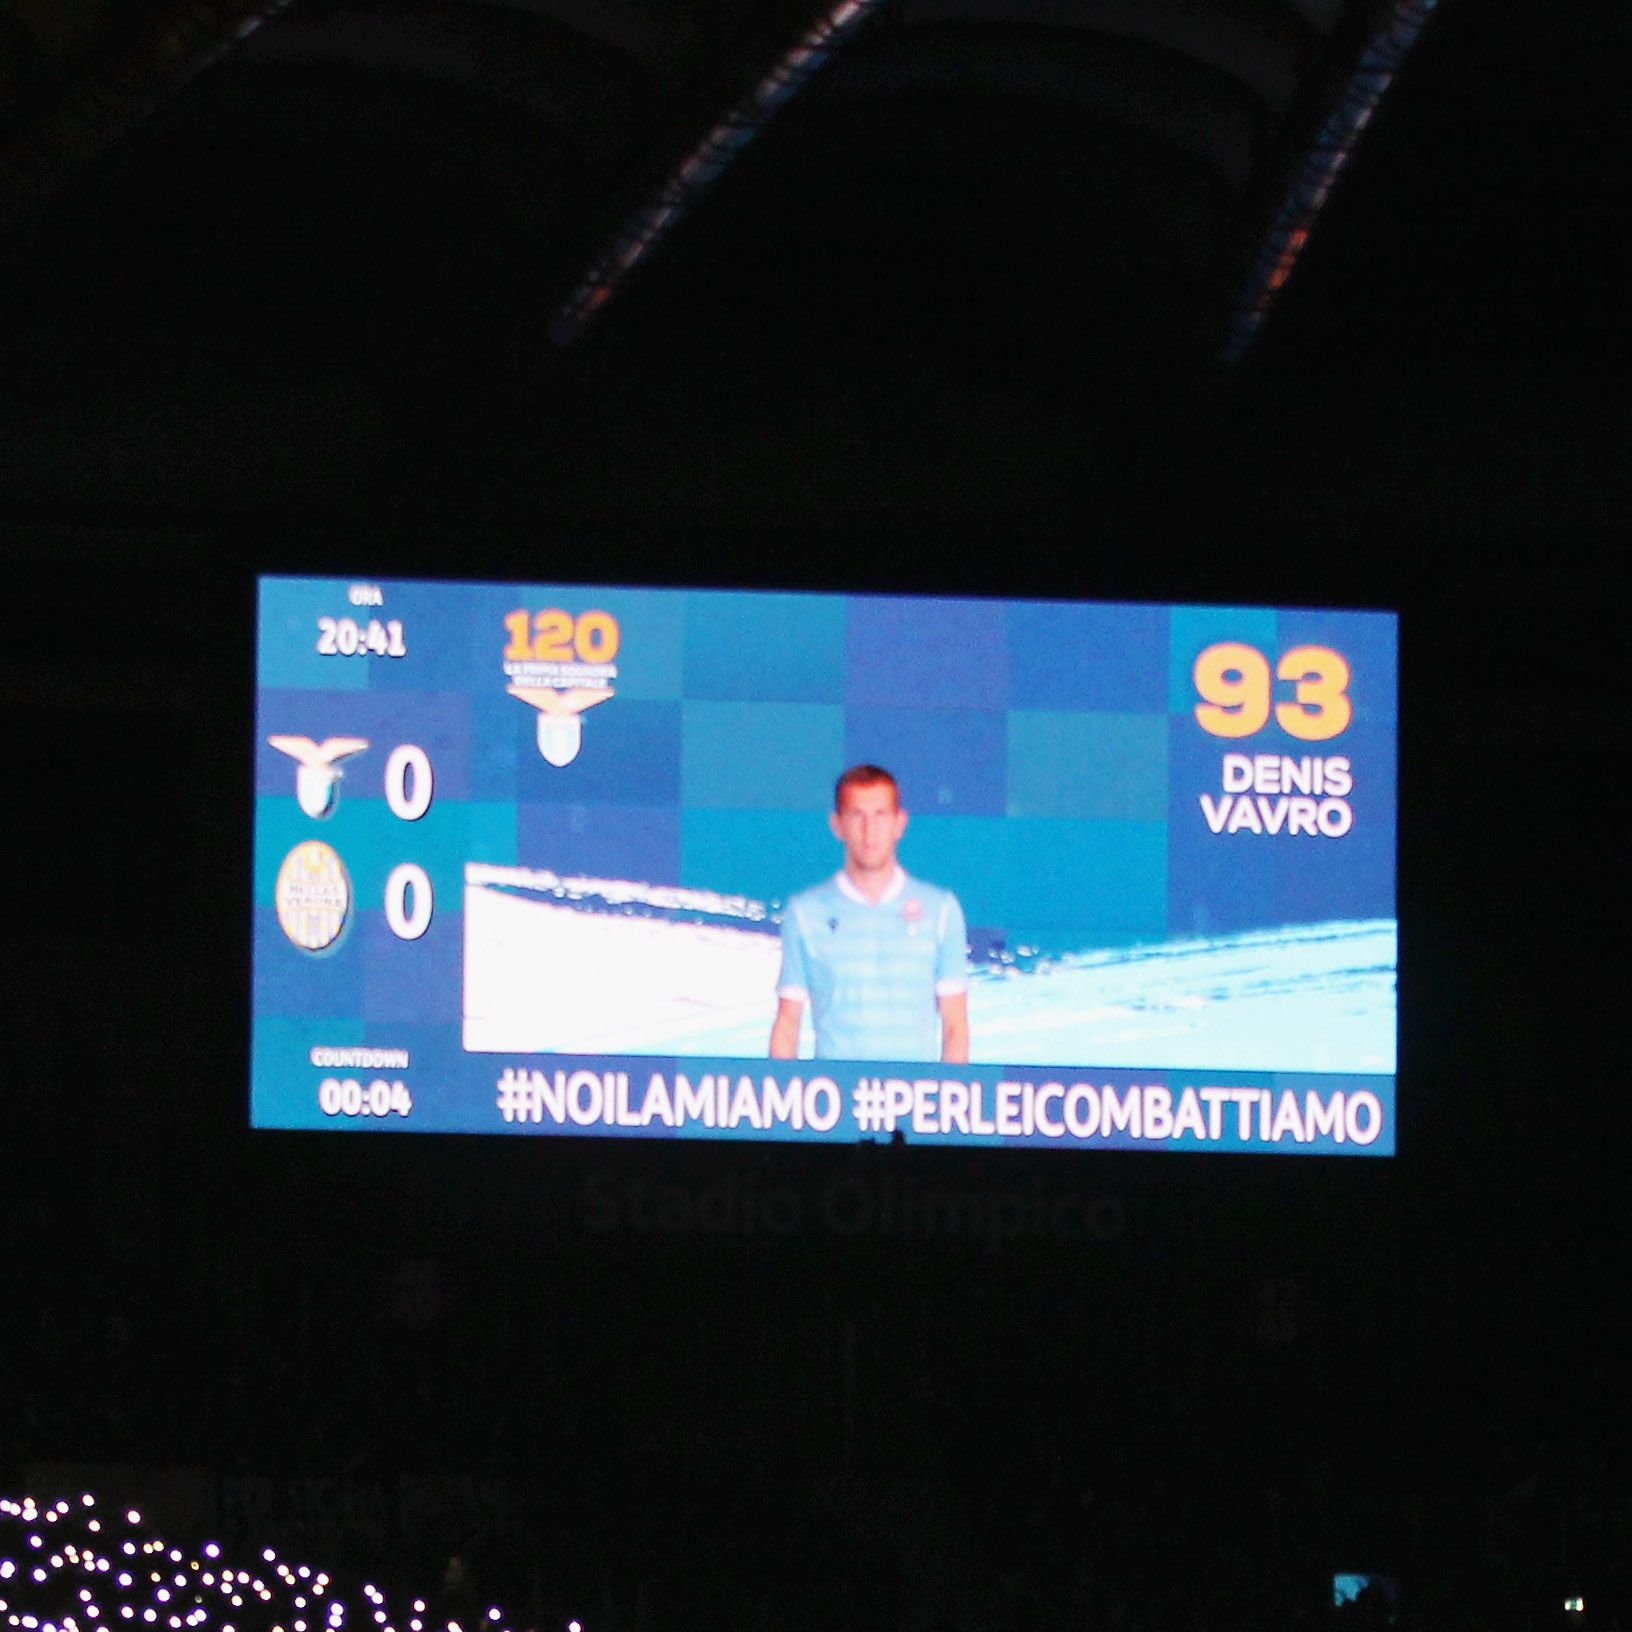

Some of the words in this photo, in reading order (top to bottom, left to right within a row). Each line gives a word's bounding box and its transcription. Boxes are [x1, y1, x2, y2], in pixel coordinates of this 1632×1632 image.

[318, 616, 407, 656] 20:41
[504, 608, 619, 664] 120
[1194, 641, 1354, 742] 93
[384, 743, 434, 822] 0
[1222, 754, 1353, 797] DENIS
[1199, 794, 1353, 838] VAVRO
[384, 862, 434, 941] 0
[309, 1046, 409, 1069] COUNTDOWN
[319, 1078, 412, 1117] 00:04
[497, 1067, 842, 1134] #NOILAMIAMO
[852, 1077, 1383, 1146] #PERLEICOMBATTIAMO
[581, 1167, 802, 1236] Stadio
[819, 1173, 1128, 1248] Olimpico
